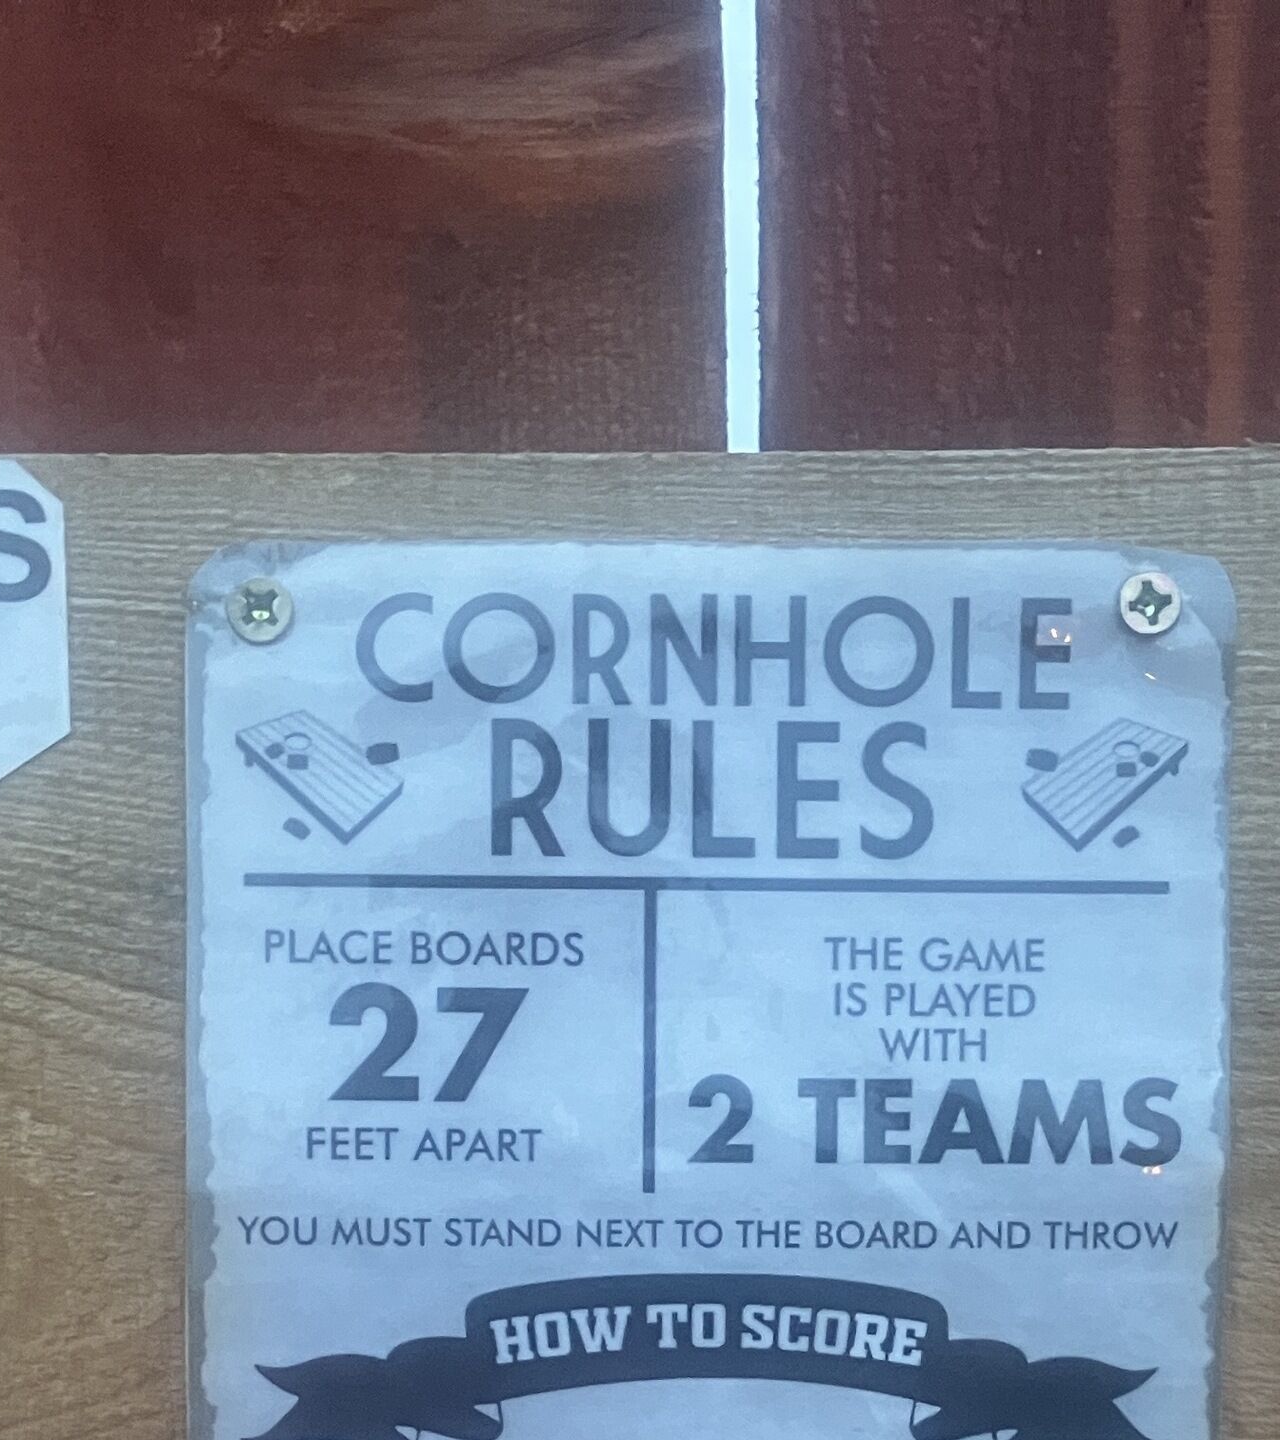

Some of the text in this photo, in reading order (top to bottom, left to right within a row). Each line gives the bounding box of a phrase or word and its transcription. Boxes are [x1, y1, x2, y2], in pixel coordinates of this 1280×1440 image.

[356, 593, 1073, 710] CORNHOLE
[491, 718, 934, 860] RULES
[265, 929, 584, 966] PLACE BOARDS
[824, 937, 1044, 972] THE GAME
[835, 982, 1035, 1017] IS PLAYED
[329, 982, 529, 1102] 27
[879, 1028, 986, 1062] WITH
[688, 1074, 1181, 1167] 2 TEAMS
[307, 1127, 542, 1161] FEET APART
[238, 1216, 1178, 1250] YOU MUST STAND NEXT TO THE BOARD AND THROW
[490, 1302, 927, 1366] HOW TO SCORE
